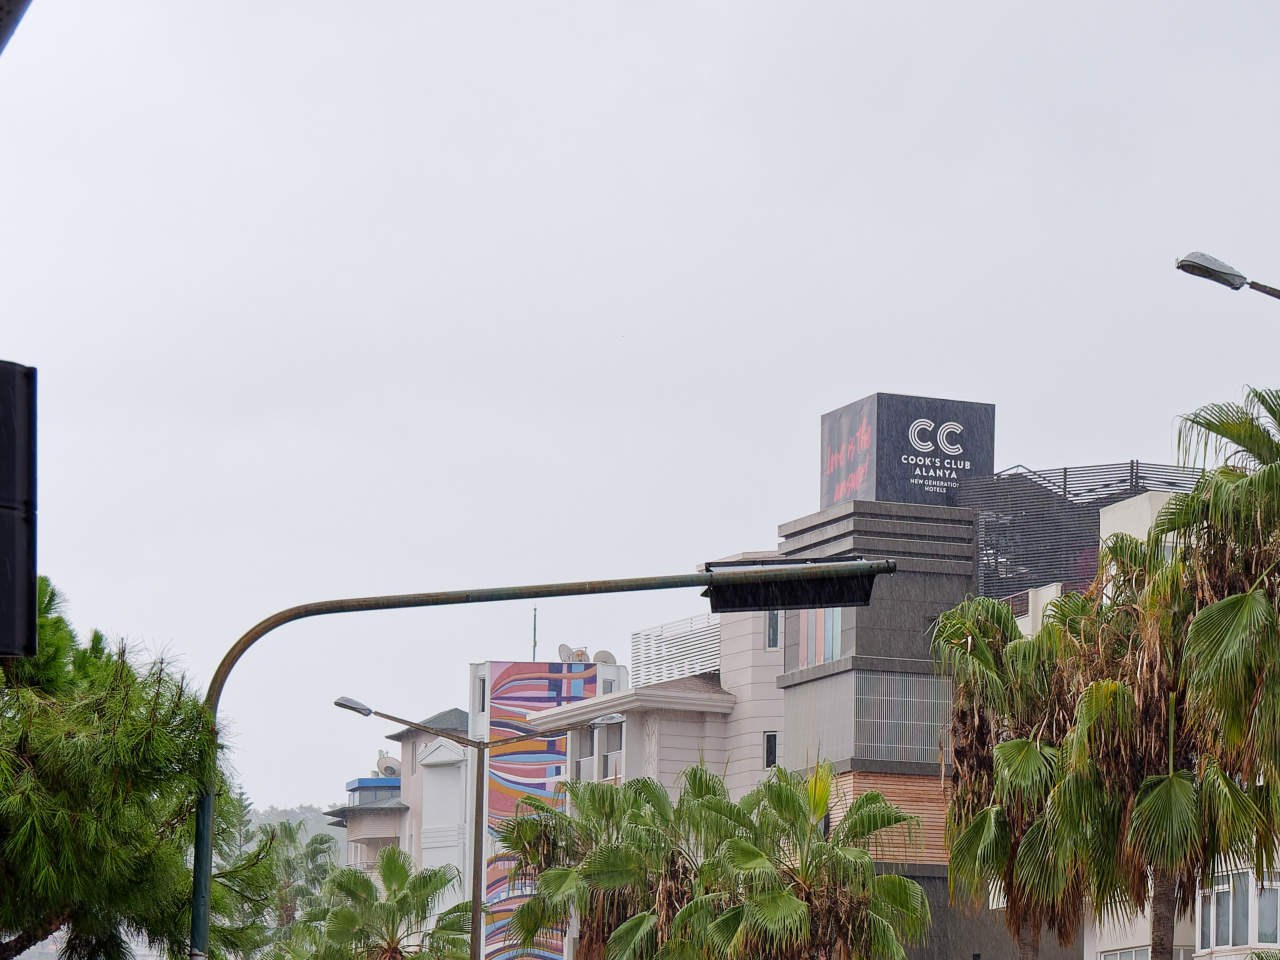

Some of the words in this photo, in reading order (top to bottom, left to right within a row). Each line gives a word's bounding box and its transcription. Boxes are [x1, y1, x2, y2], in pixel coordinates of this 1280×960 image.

[908, 418, 964, 456] CC
[901, 455, 941, 467] COOK'S
[944, 459, 971, 470] CLUB
[914, 467, 958, 479] ALANYA
[924, 486, 947, 494] HOTELS
